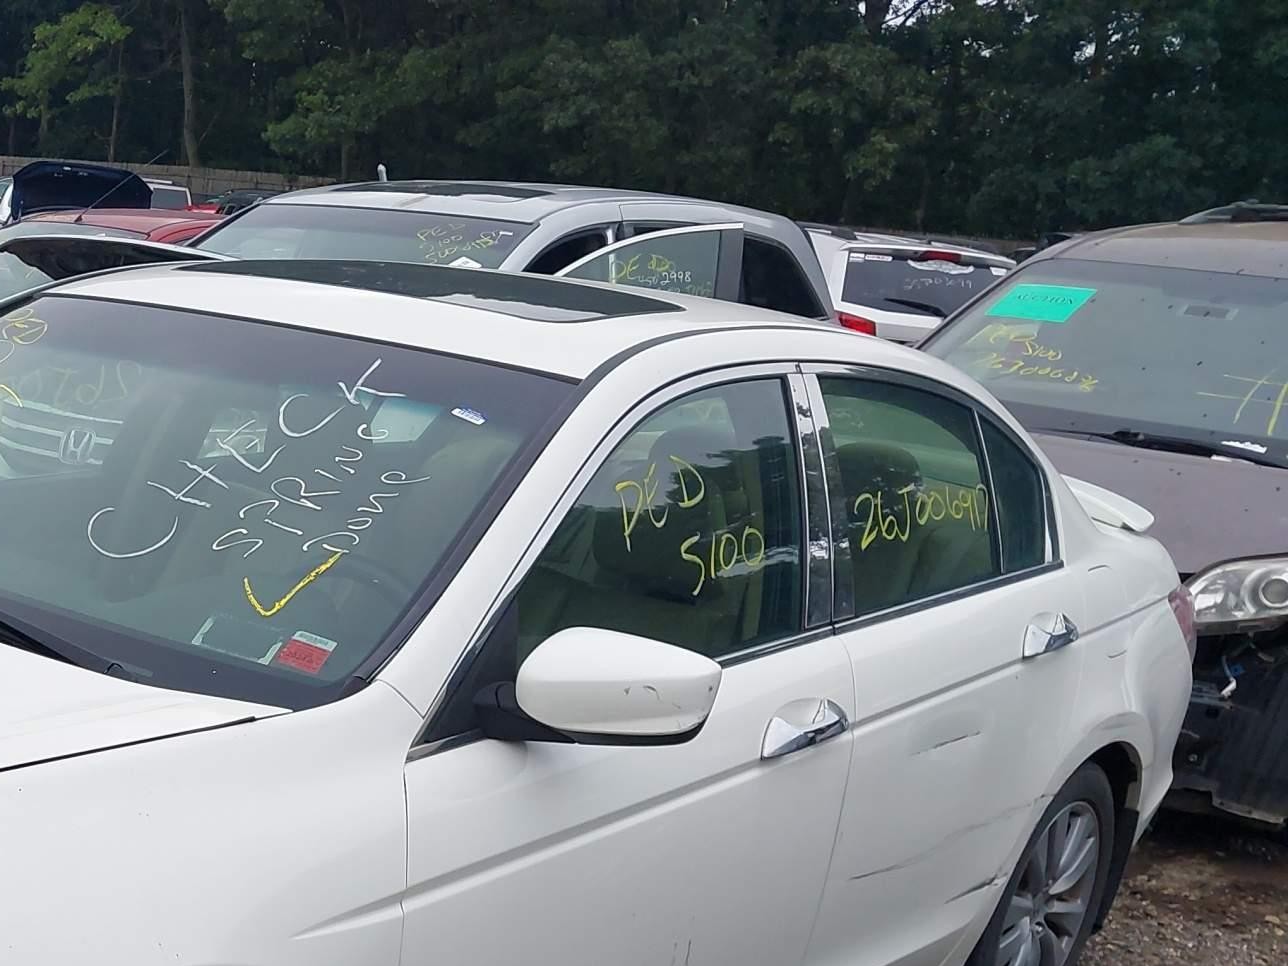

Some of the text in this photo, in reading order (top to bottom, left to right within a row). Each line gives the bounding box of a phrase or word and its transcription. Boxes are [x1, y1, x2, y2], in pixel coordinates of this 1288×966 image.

[659, 271, 692, 286] 2998
[87, 357, 407, 558] CHECK
[615, 454, 706, 553] PED
[679, 525, 765, 597] S100
